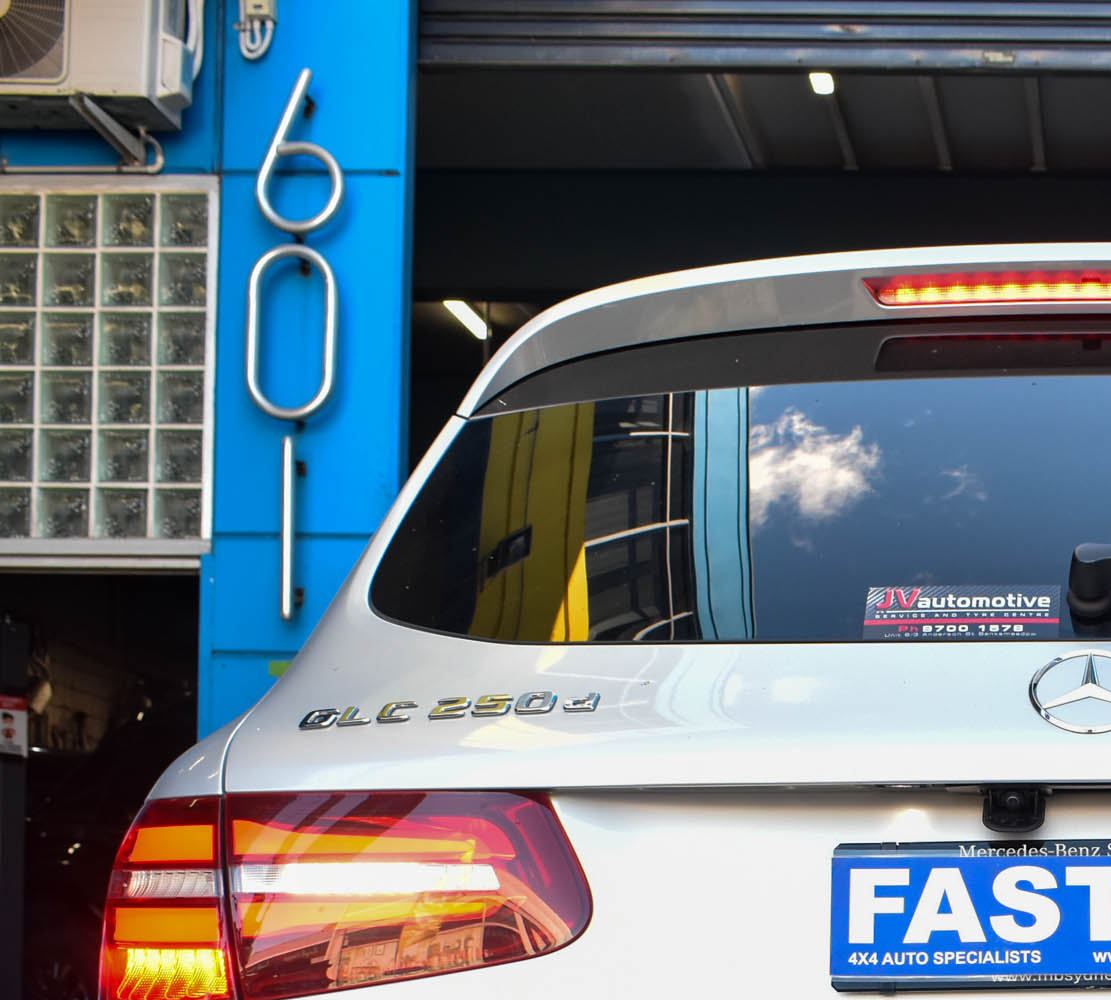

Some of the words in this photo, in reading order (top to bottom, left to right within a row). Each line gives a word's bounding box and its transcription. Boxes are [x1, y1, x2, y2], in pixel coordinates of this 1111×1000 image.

[298, 700, 418, 730] GLC
[848, 952, 878, 965] 4X4
[881, 951, 929, 965] AUTO
[933, 950, 1042, 965] SPECIALISTS
